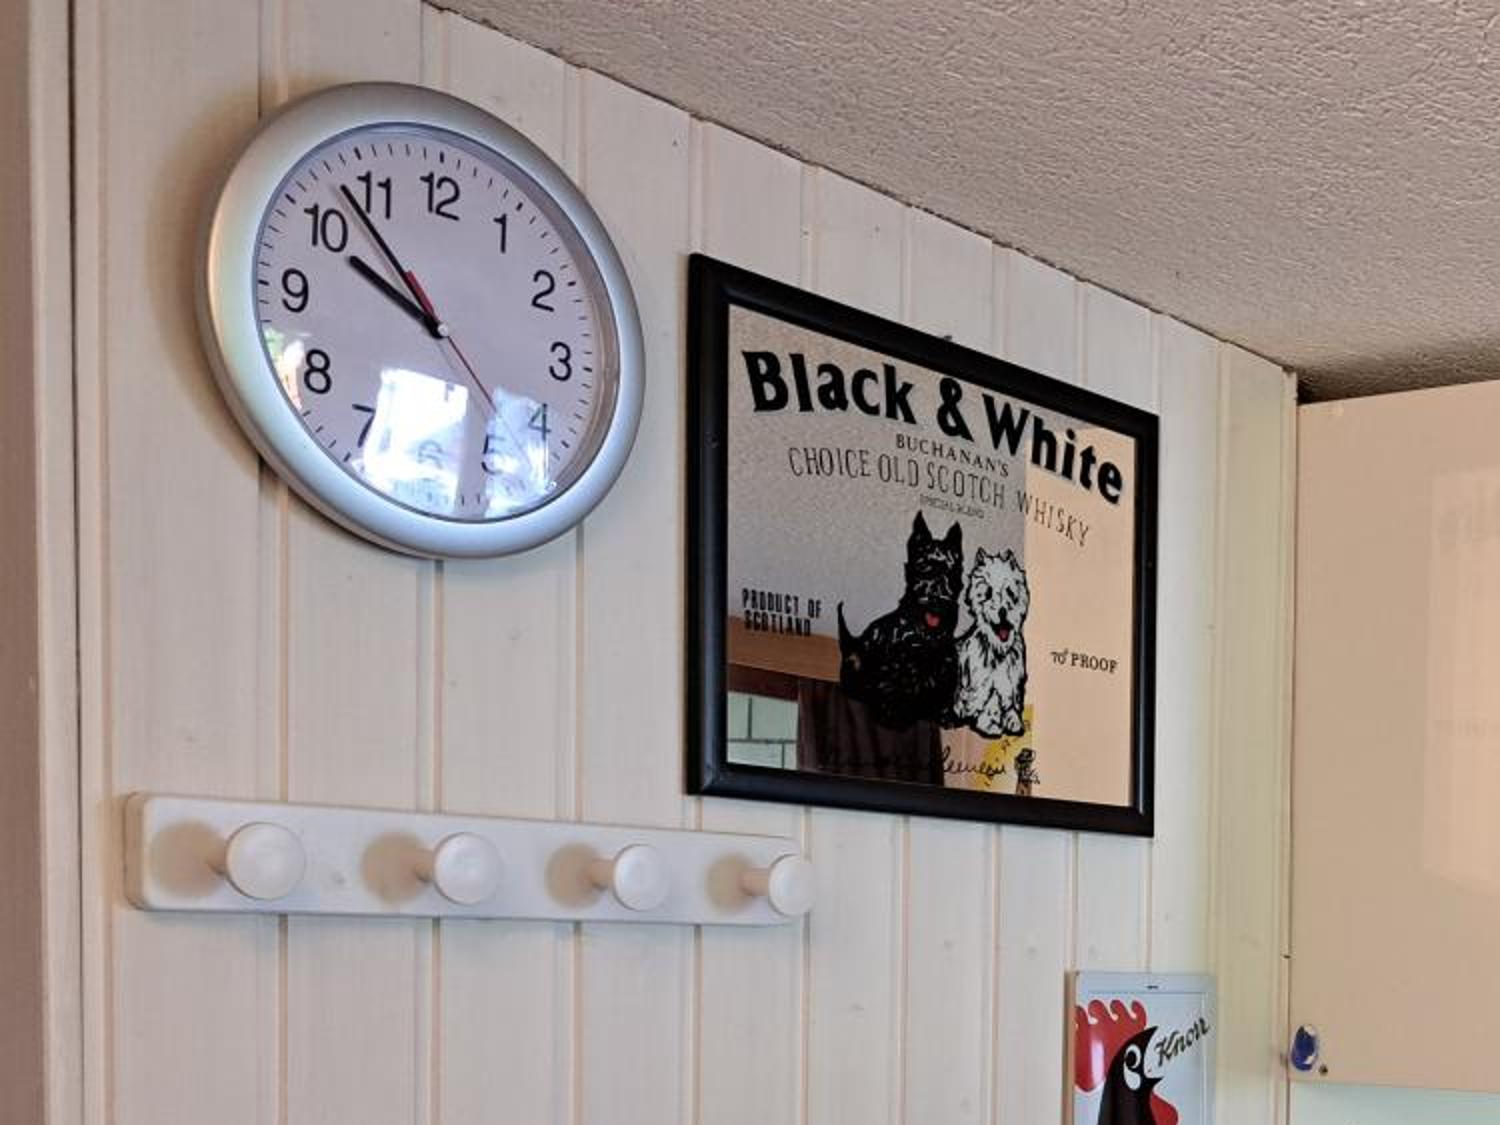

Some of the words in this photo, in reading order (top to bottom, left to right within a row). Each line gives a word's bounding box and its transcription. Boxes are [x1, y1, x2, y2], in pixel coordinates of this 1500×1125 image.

[357, 170, 393, 219] 11
[419, 171, 461, 221] 12
[304, 203, 349, 253] 10
[493, 212, 507, 254] 1
[281, 267, 310, 313] 9
[530, 269, 556, 312] 2
[303, 348, 332, 395] 8
[548, 341, 573, 381] 3
[351, 403, 377, 448] 7
[527, 402, 552, 442] 4
[742, 349, 916, 425] Black
[935, 376, 975, 443] &
[981, 391, 1124, 506] White
[481, 433, 506, 476] 5
[895, 433, 1010, 478] BUCHANAN'S
[788, 446, 871, 479] CHOICE
[878, 453, 920, 489] OLD
[926, 461, 1005, 510] SCOTCH
[1016, 489, 1090, 548] WHISKY
[742, 587, 799, 616] PRODUCT
[808, 597, 822, 619] OF
[744, 609, 811, 637] SCOTLAND
[1070, 651, 1118, 674] PROOF
